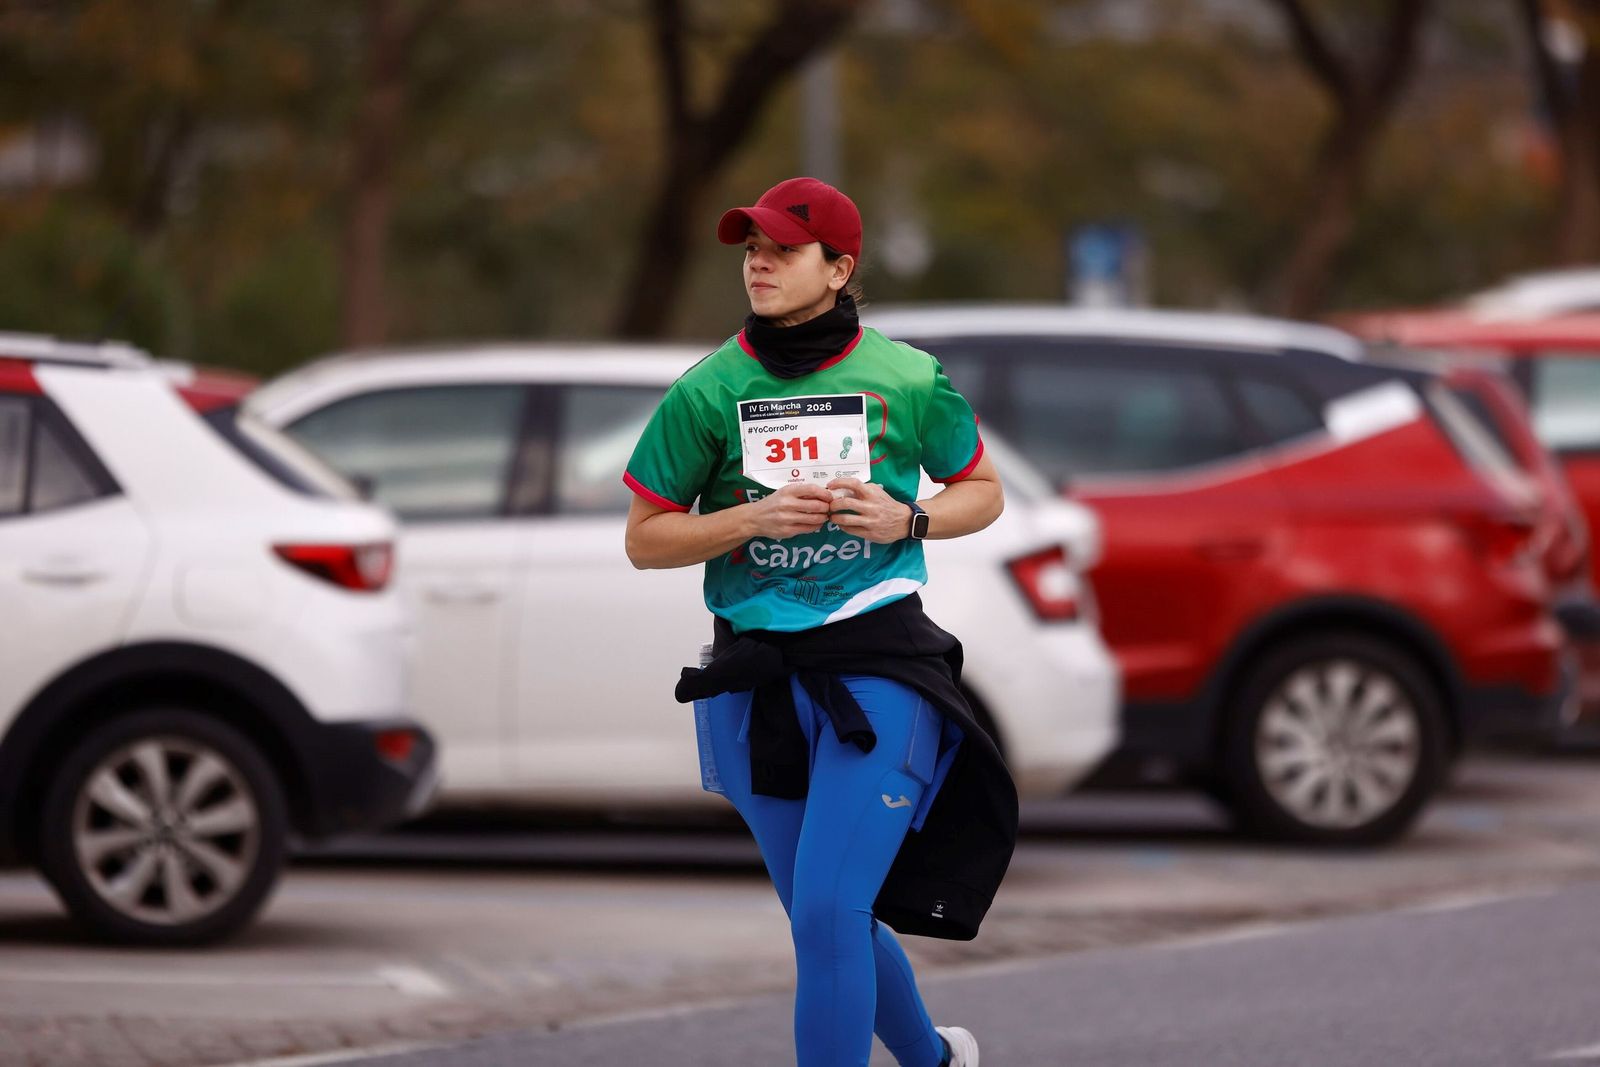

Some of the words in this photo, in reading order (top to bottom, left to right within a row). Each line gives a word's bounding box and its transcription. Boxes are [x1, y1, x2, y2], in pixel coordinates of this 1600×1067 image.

[749, 405, 758, 413] IV
[759, 404, 769, 412] En
[770, 402, 801, 411] Marcha
[806, 402, 832, 412] 2026
[748, 424, 798, 435] #YoCorroPor
[765, 436, 819, 463] 311
